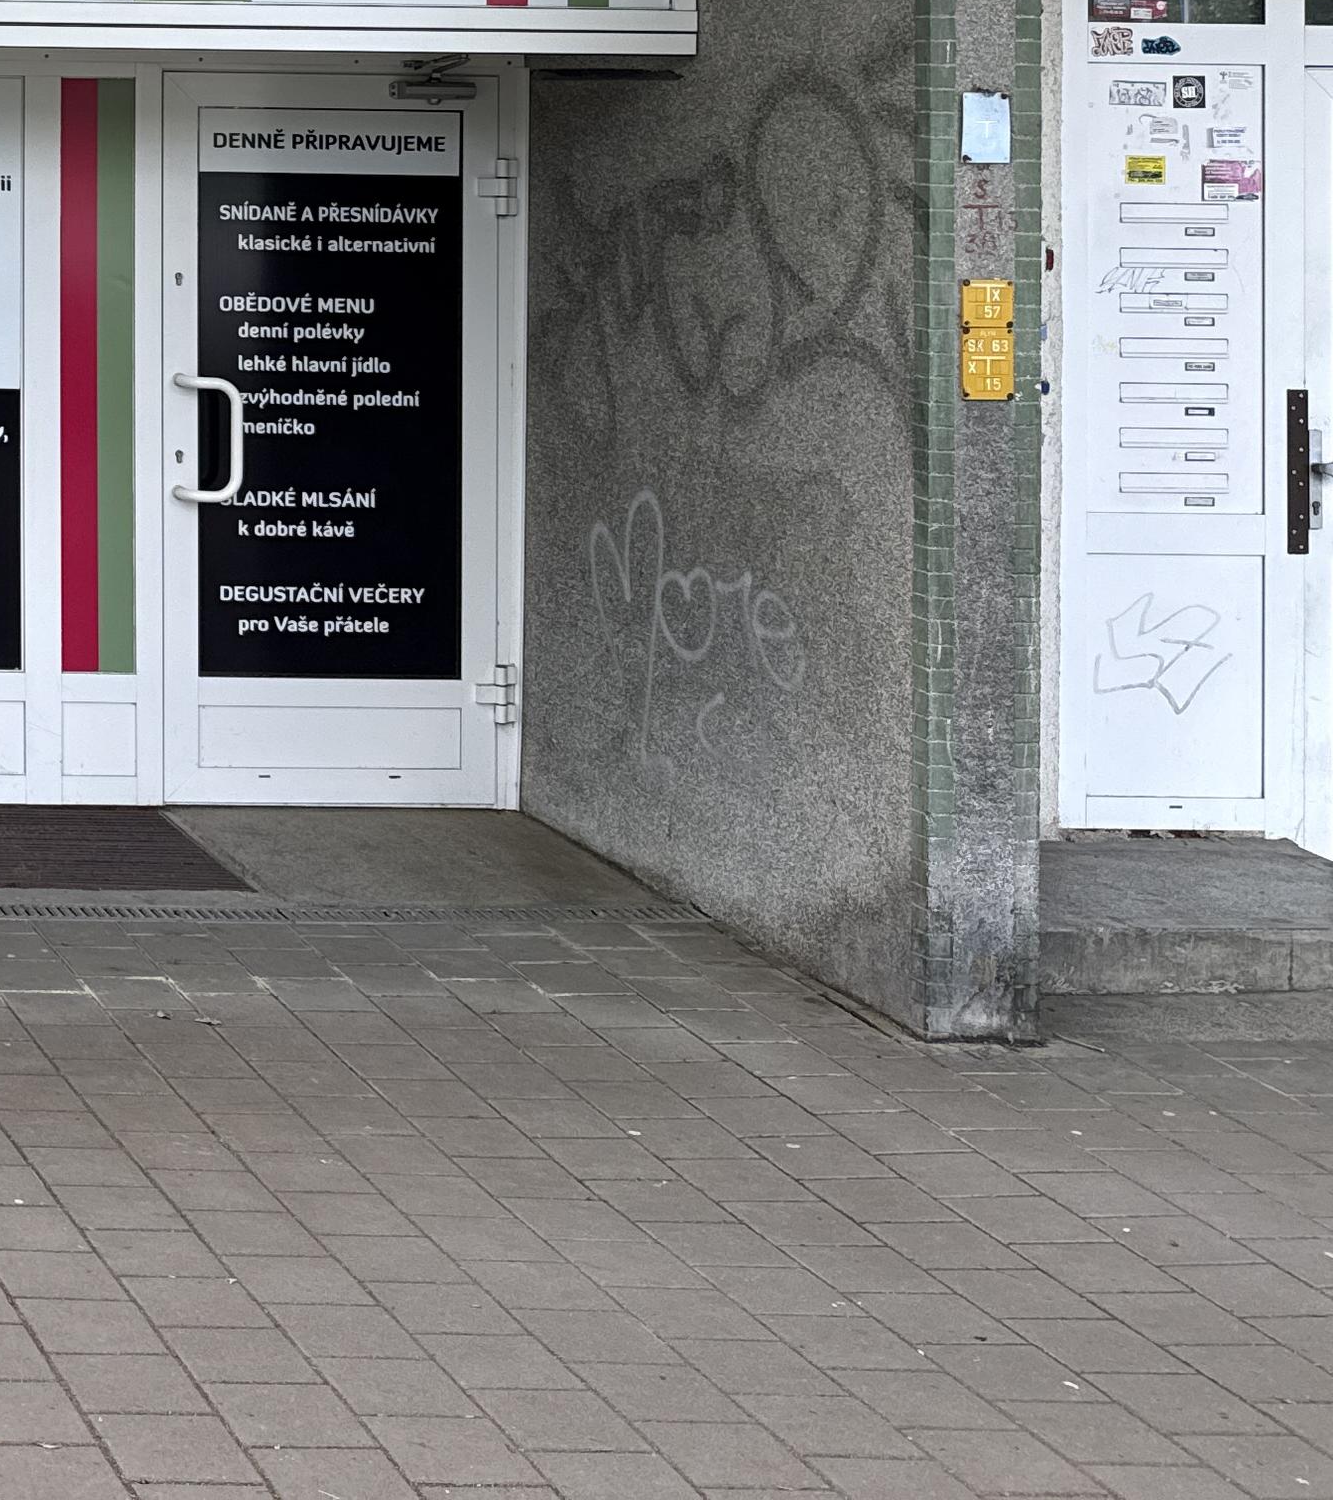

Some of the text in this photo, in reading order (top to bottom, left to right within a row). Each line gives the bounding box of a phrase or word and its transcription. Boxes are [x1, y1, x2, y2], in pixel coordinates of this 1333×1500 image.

[213, 129, 445, 155] DENNĚ PŘIPRAVUJEME
[219, 201, 438, 223] SNÍDANĚ A PŘESNÍDÁVKY
[238, 234, 435, 253] klasické i alternativní
[219, 292, 374, 314] OBĚDOVÉ MENU
[984, 306, 1001, 318] 57
[238, 322, 365, 343] denní polévky
[967, 340, 1008, 352] SK 63
[238, 355, 390, 377] lehké hlavní jídlo
[968, 362, 976, 373] X
[986, 378, 1001, 390] 15
[240, 389, 419, 410] zvýhodněné polední
[302, 488, 376, 508] MLSÁNÍ
[238, 520, 355, 538] k dobré kávě
[220, 583, 425, 604] DEGUSTAČNÍ VEČERY
[238, 617, 389, 637] pro Vaše přátele
